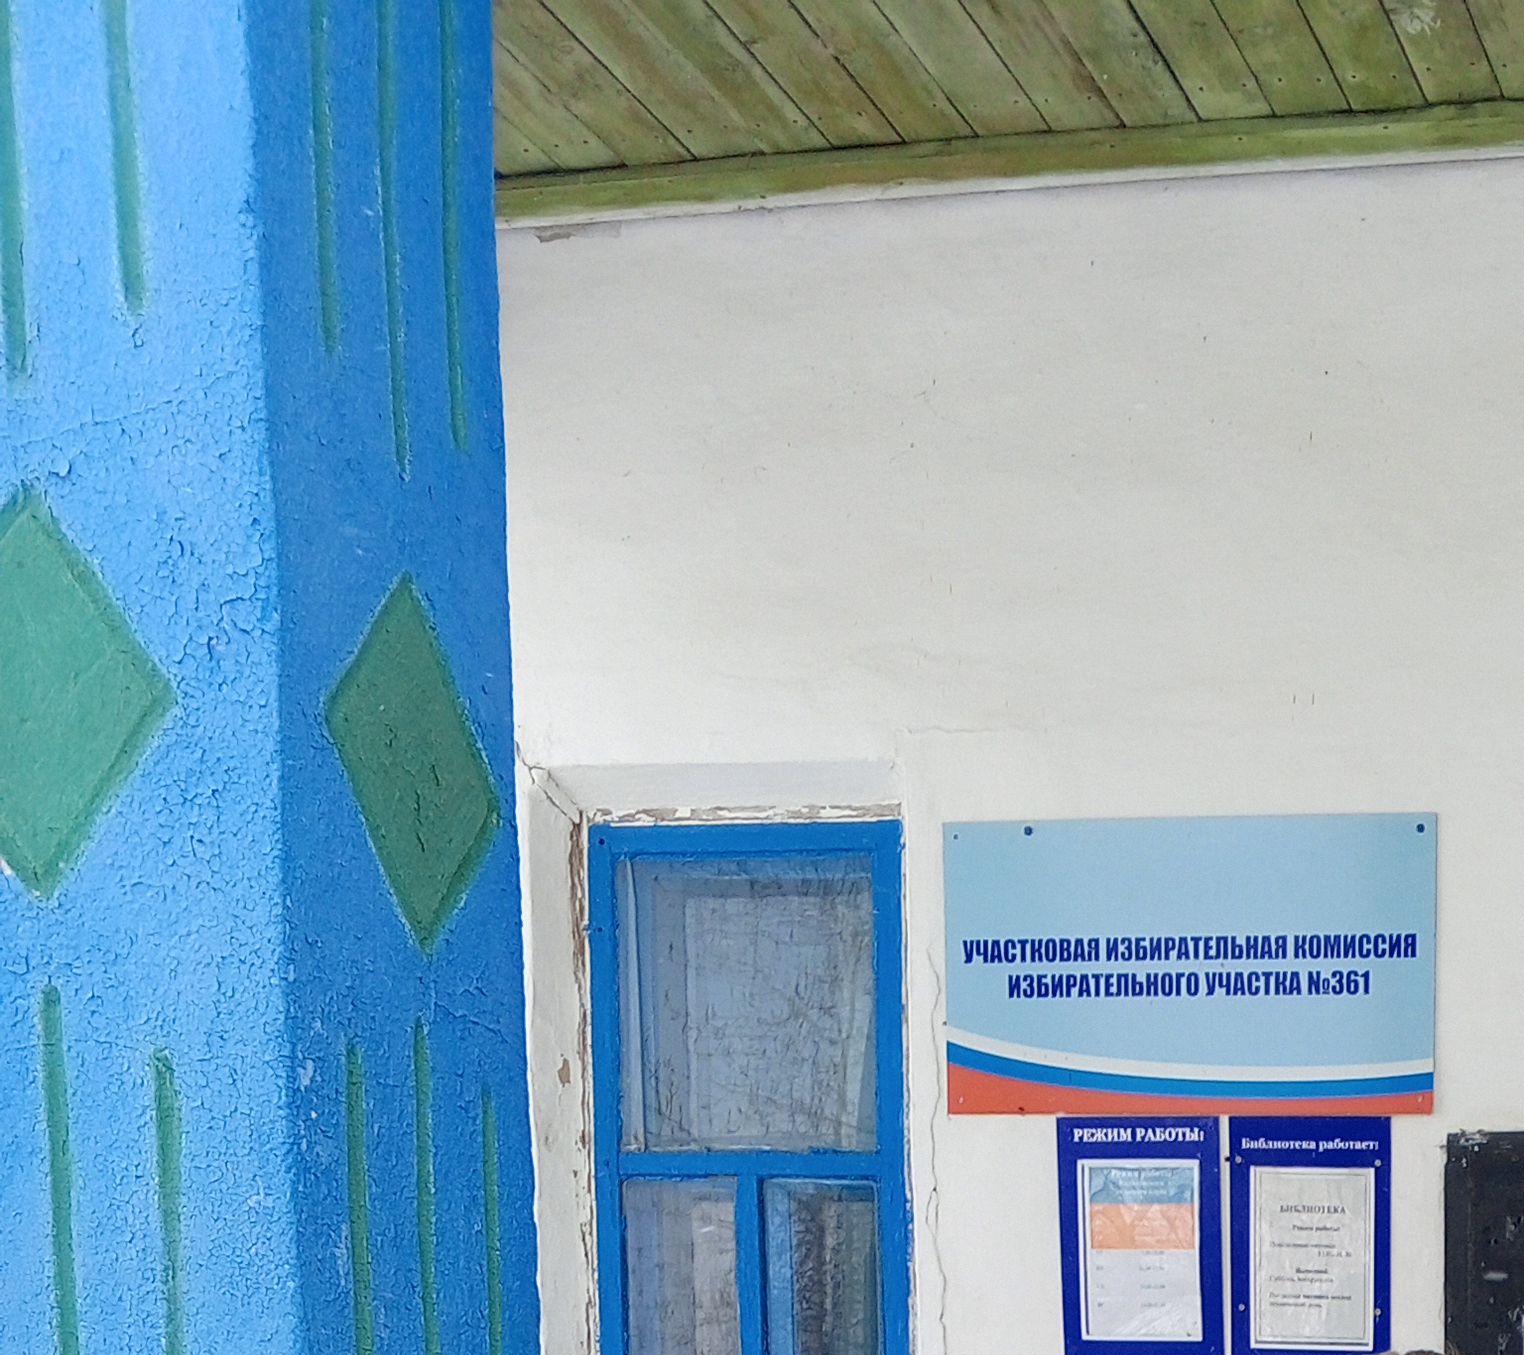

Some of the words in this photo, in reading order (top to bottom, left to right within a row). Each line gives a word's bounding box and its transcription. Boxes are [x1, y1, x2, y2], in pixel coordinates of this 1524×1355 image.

[962, 937, 1100, 964] УЧАСТКОВАЯ
[1105, 935, 1288, 962] ИЗБИРАТЕЛЬНАЯ
[1294, 933, 1418, 960] КОМИССИЯ
[1007, 972, 1200, 999] ИЗБИРАТЕЛЬНОГО
[1204, 971, 1302, 997] УЧАСТКА
[1307, 970, 1371, 996] №361
[1073, 1127, 1133, 1143] РЕЖИМ
[1241, 1137, 1317, 1150] Библиотека
